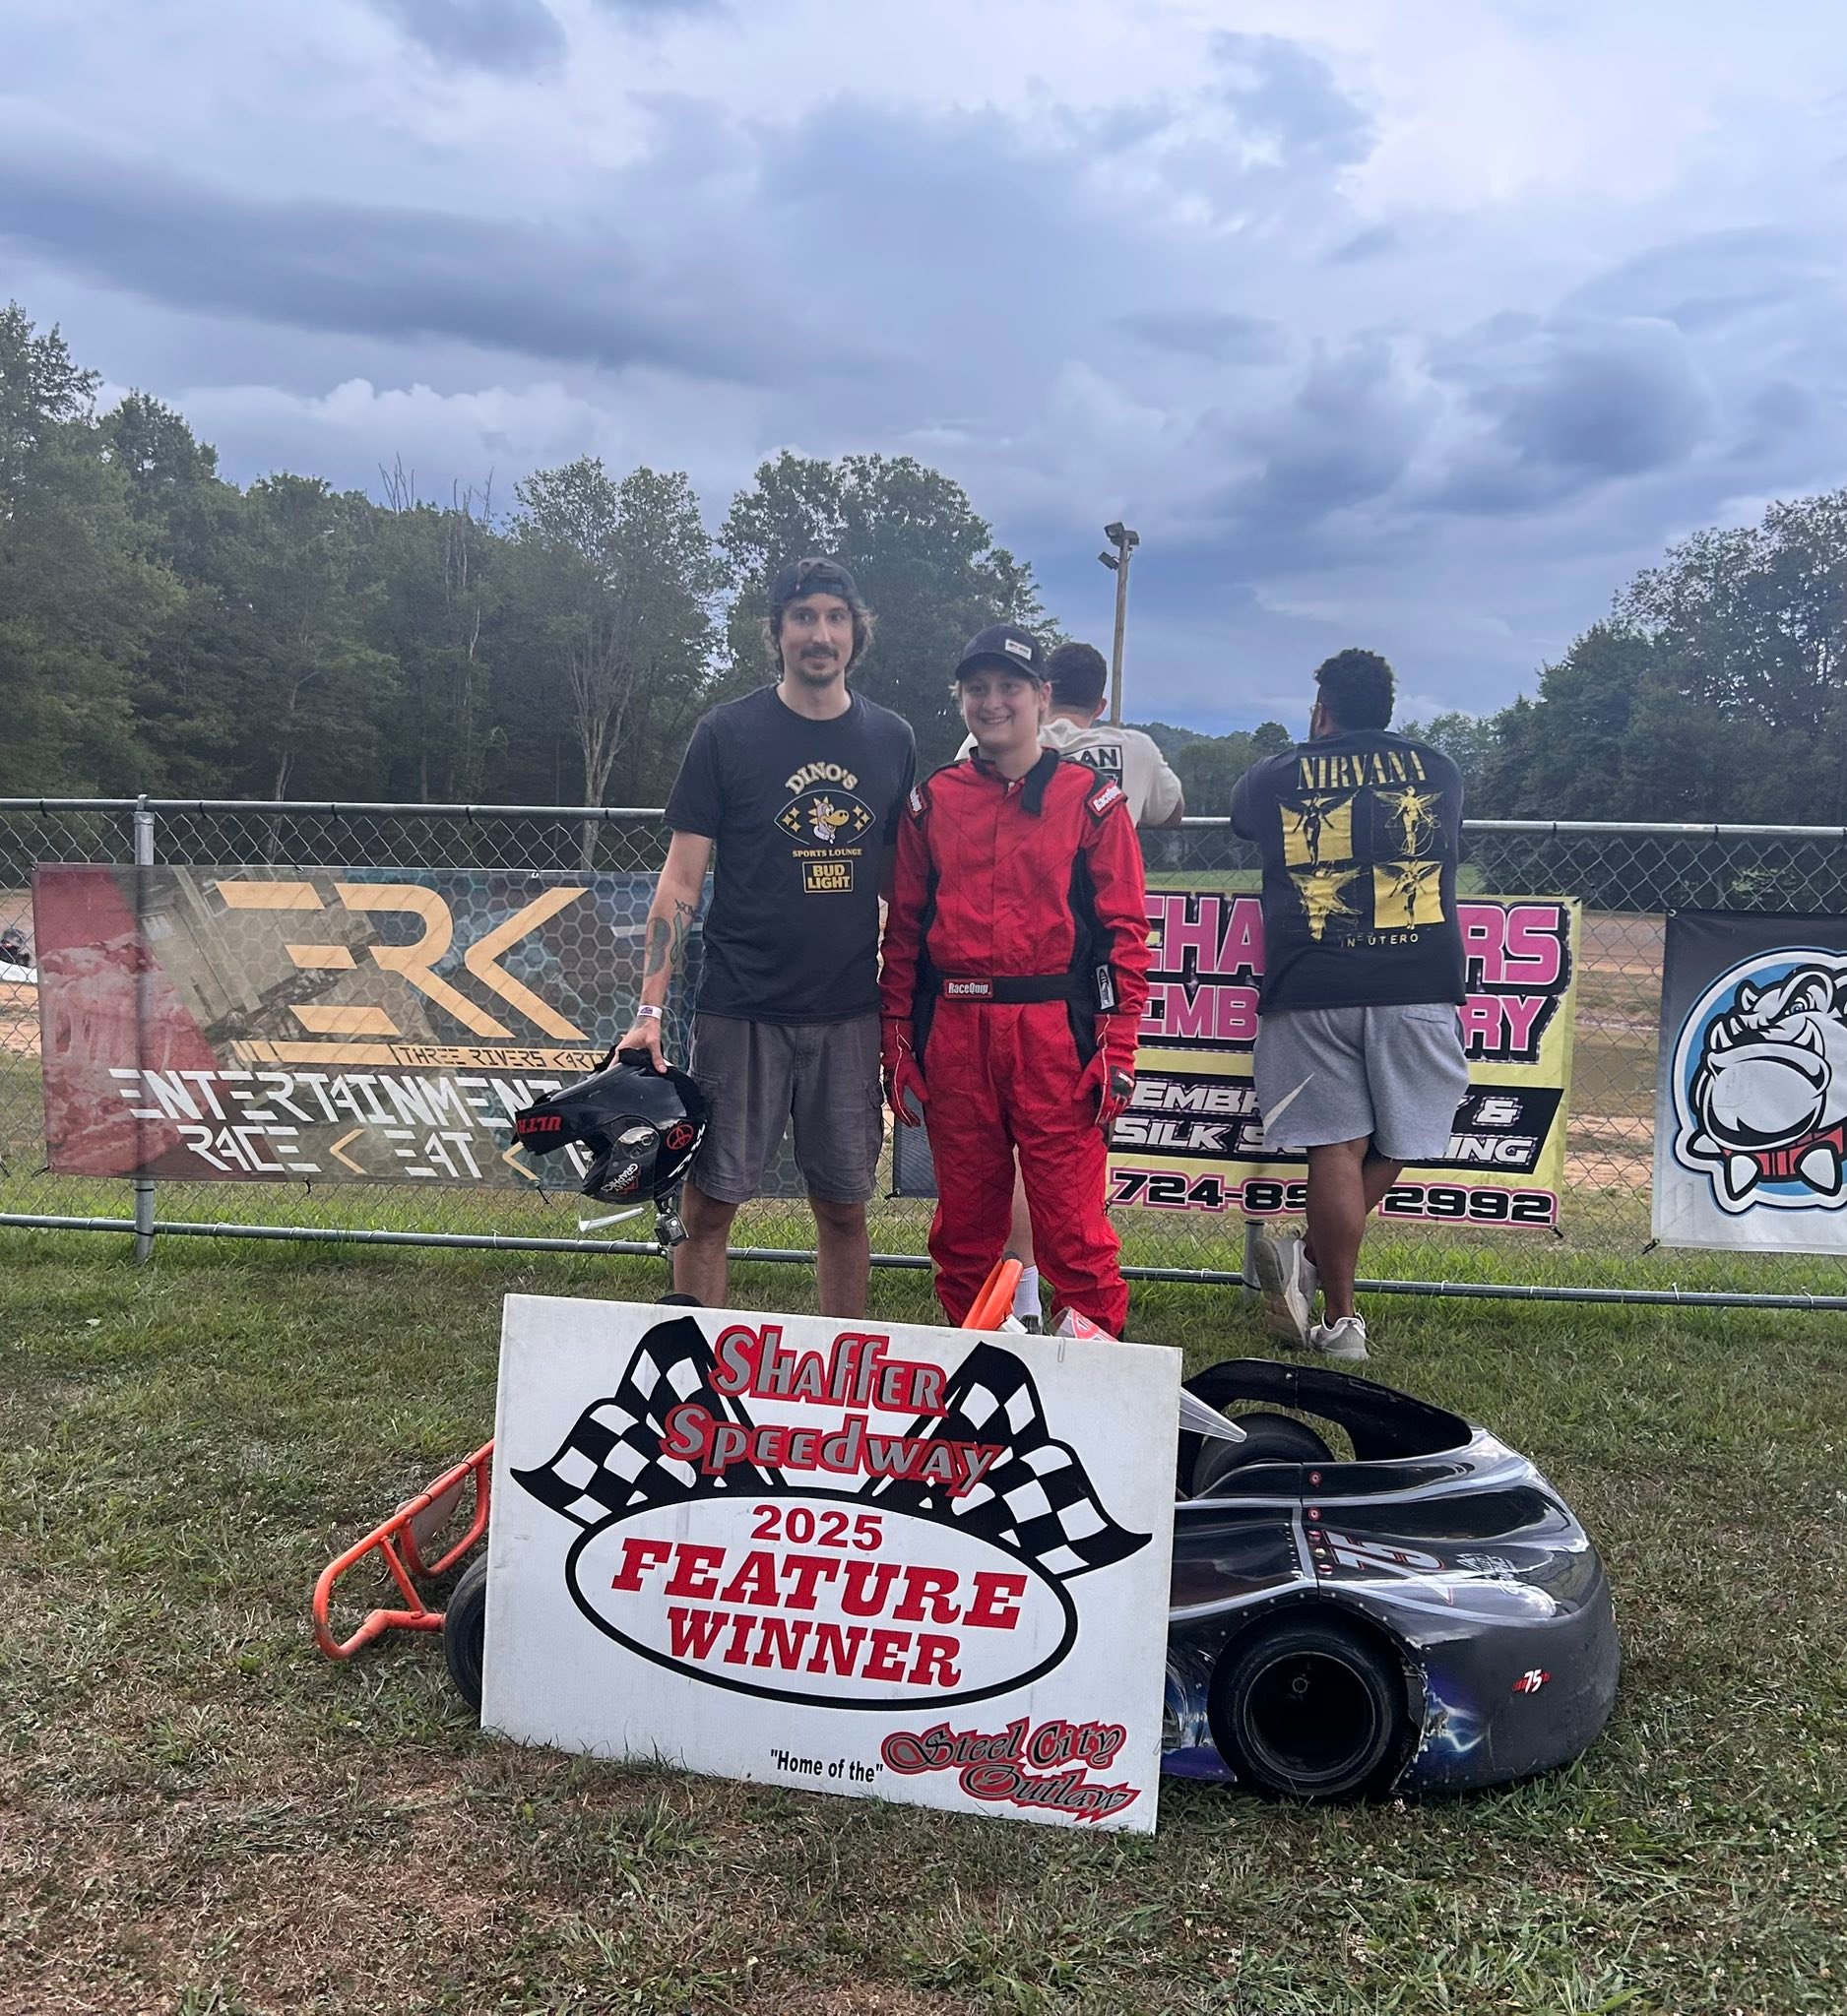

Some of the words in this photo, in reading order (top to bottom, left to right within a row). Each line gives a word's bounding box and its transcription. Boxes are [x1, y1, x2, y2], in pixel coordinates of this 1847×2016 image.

[785, 762, 859, 795] DINO'S
[1297, 750, 1426, 789] NIRVANA
[807, 876, 851, 889] LIGHT
[812, 864, 845, 876] BUD
[1368, 933, 1419, 946] UTERO
[398, 1046, 466, 1065] THREE
[469, 1049, 547, 1068] RIVERS
[516, 1115, 562, 1135] ULTR
[1112, 1115, 1231, 1150] SILK
[176, 1124, 322, 1172] RACE
[383, 1129, 482, 1178] EAT
[750, 1504, 883, 1550] 2025
[610, 1538, 1029, 1630] FEATURE
[667, 1606, 962, 1688] WINNER
[1523, 1669, 1543, 1693] 75
[883, 1720, 1027, 1772] Steel
[1030, 1722, 1124, 1769] City
[770, 1748, 823, 1776] "Home
[828, 1758, 846, 1779] of
[849, 1760, 884, 1783] the"
[962, 1763, 1134, 1815] Outlaw
